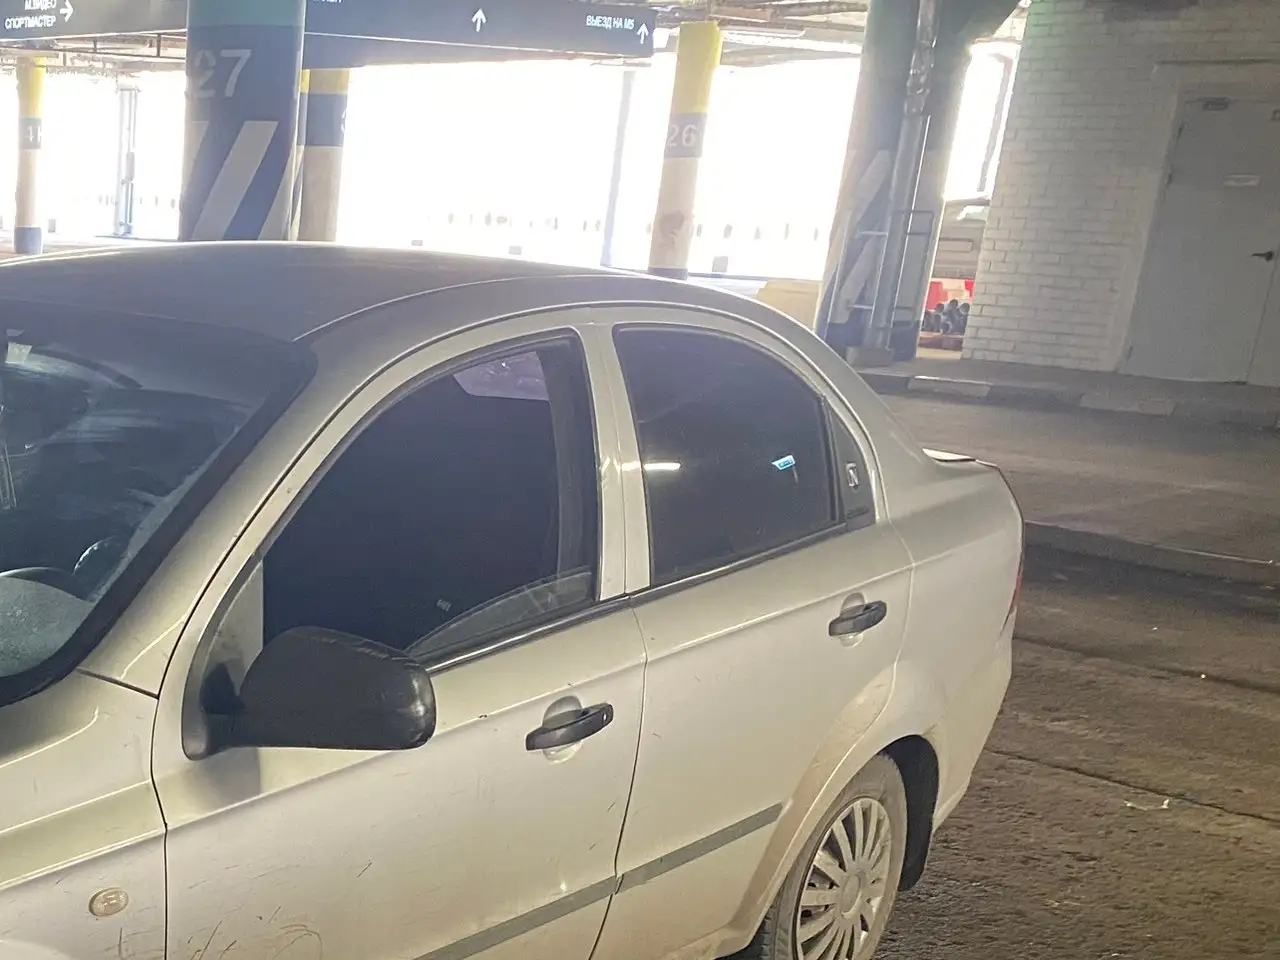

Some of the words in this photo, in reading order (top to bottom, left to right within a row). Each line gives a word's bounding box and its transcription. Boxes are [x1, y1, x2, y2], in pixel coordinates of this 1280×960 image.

[4, 15, 56, 29] СПОРТМАСТЕР
[586, 15, 613, 31] ВЫЕЗД
[613, 17, 623, 28] НА
[624, 18, 635, 30] М5
[194, 49, 252, 99] 27
[666, 123, 697, 148] 26
